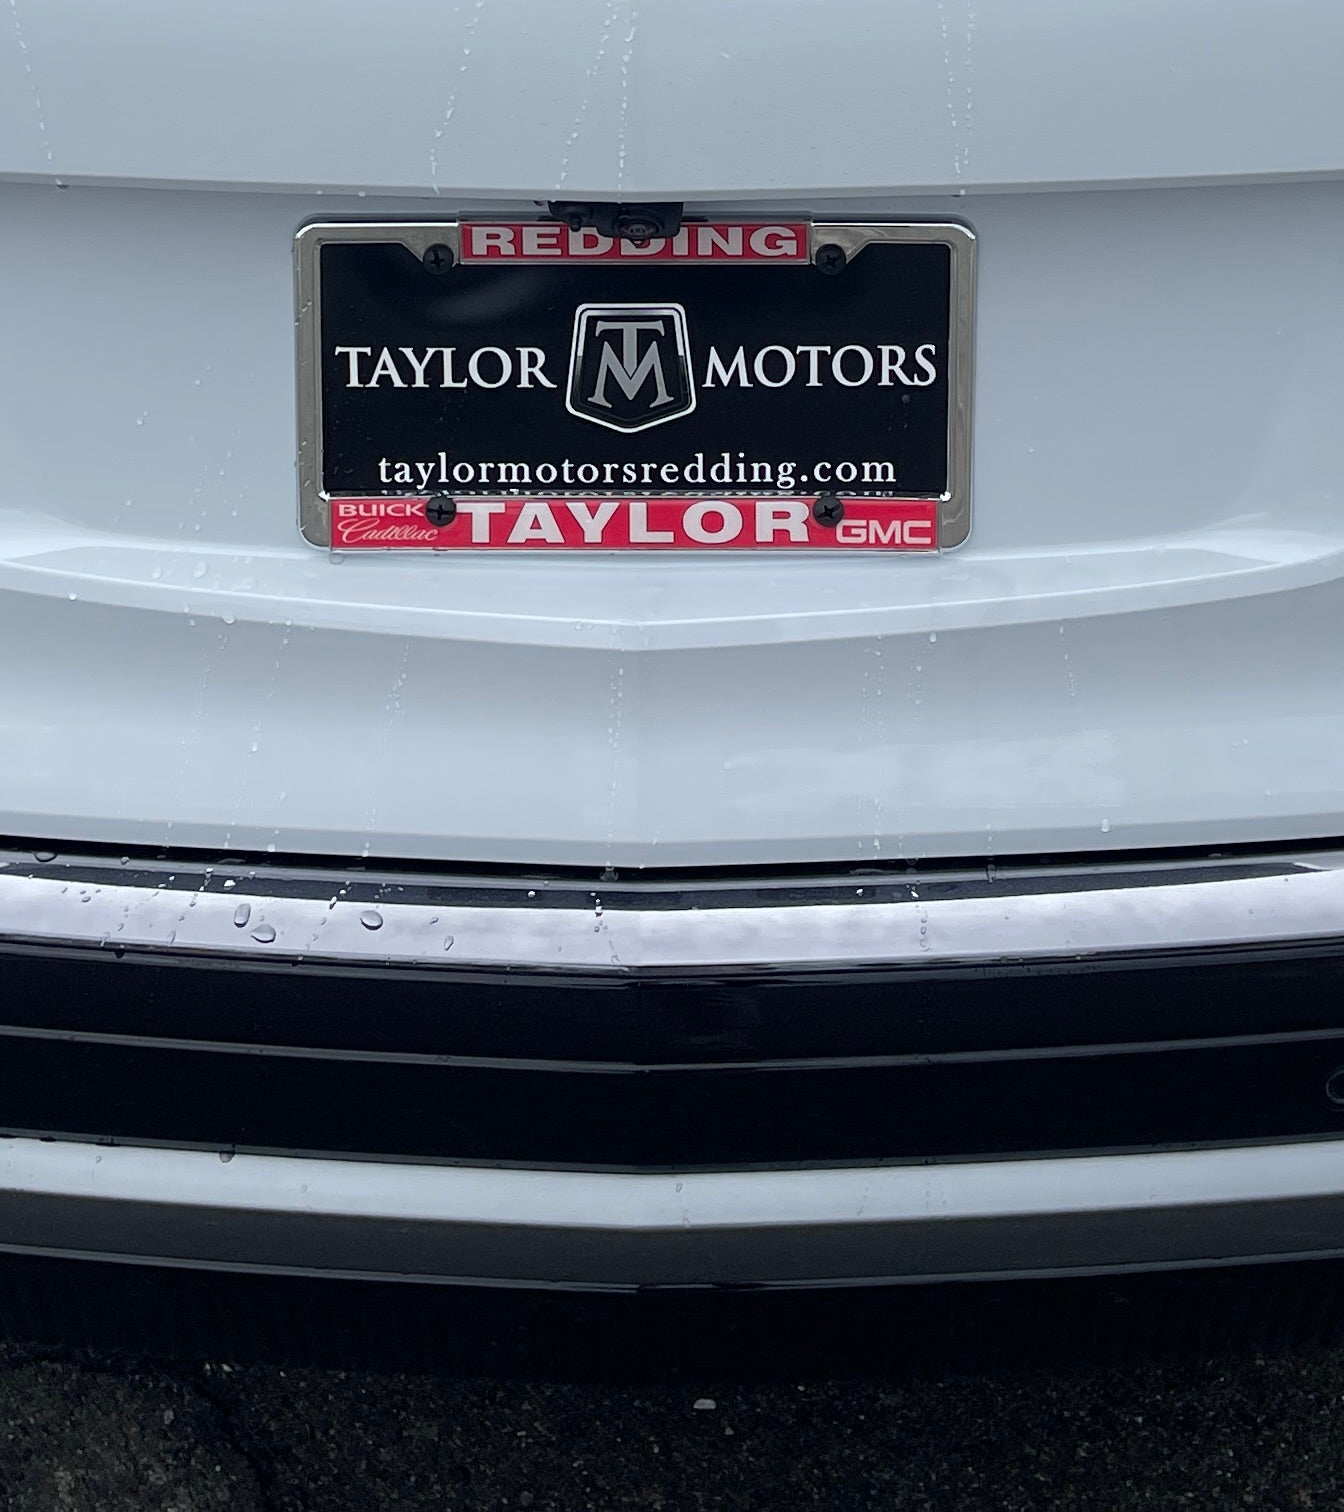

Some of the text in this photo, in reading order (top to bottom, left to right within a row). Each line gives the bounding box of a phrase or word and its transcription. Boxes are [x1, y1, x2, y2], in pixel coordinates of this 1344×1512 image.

[470, 225, 798, 256] REDDING
[334, 345, 558, 389] TAYLOR
[701, 344, 937, 388] MOTORS
[377, 452, 897, 488] taylormotorsredding.com
[338, 503, 425, 517] BUICK
[456, 500, 810, 544] TAYLOR
[337, 518, 439, 544] Cadillac
[835, 519, 932, 545] GMC
